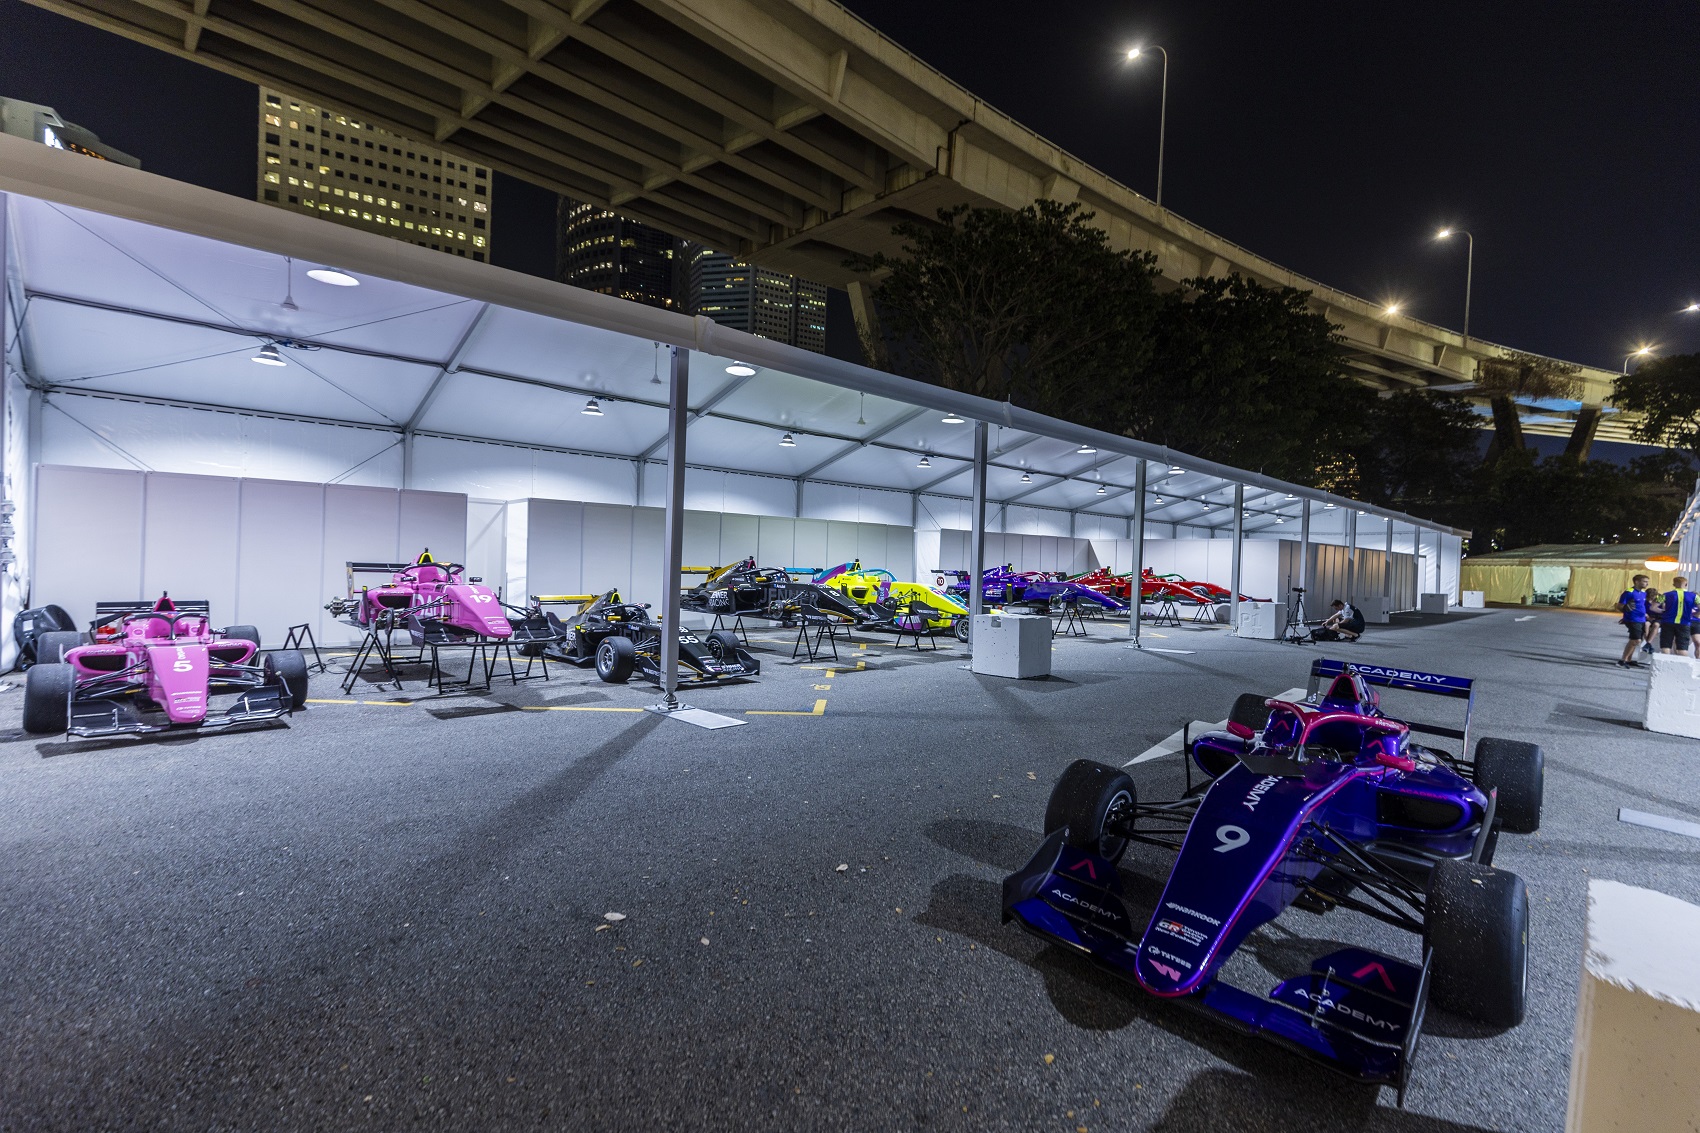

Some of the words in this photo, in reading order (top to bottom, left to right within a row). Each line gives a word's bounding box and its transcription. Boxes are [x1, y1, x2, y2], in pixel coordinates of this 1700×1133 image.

[469, 594, 492, 604] 19
[679, 635, 699, 644] 55
[173, 660, 194, 672] 5
[1349, 664, 1447, 684] ACADEMY
[1242, 775, 1280, 811] ADEMY
[1399, 788, 1448, 799] ACADEMY
[1213, 824, 1251, 853] 9
[1051, 889, 1122, 920] ACADEMY
[1159, 921, 1181, 934] GR
[1294, 988, 1400, 1032] ACADEMY
